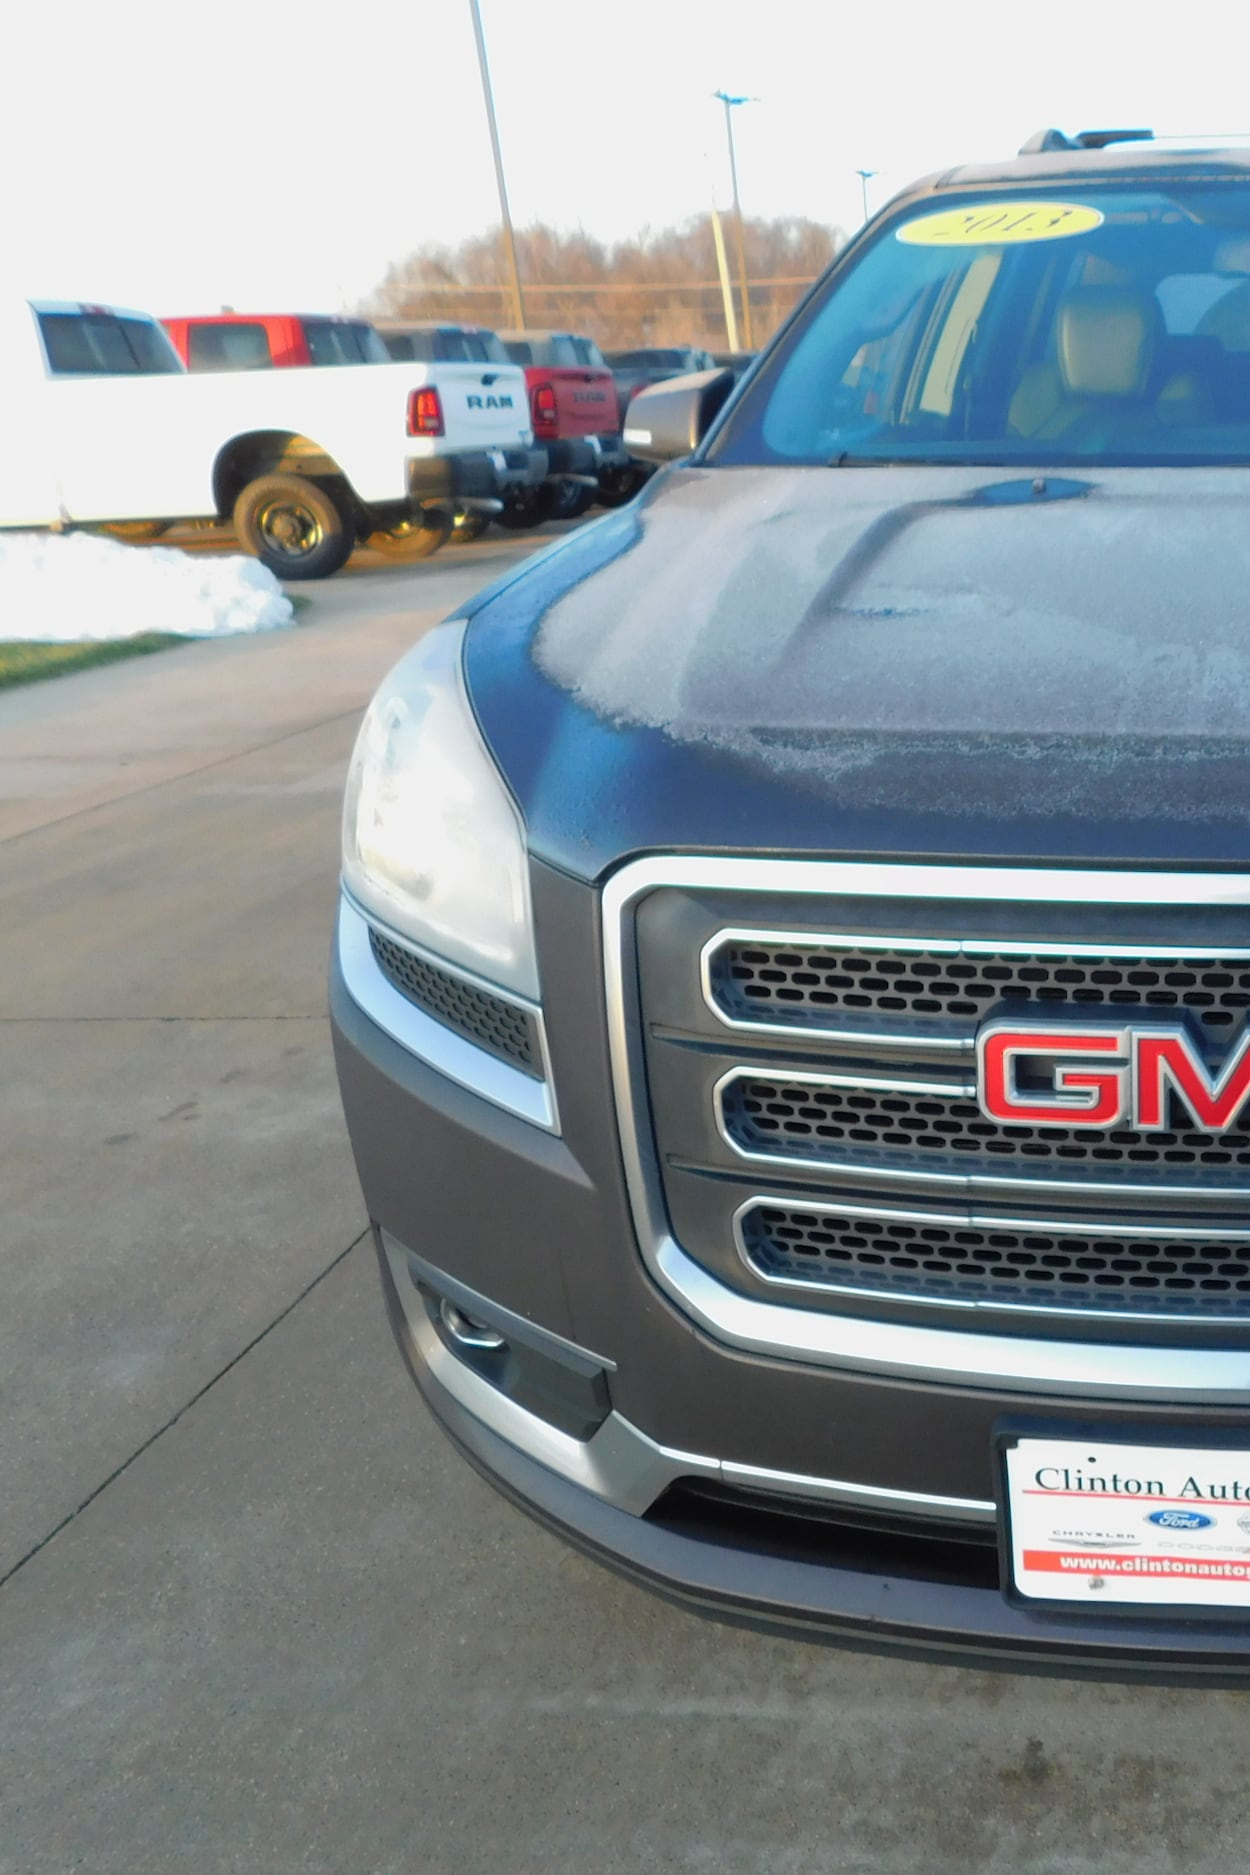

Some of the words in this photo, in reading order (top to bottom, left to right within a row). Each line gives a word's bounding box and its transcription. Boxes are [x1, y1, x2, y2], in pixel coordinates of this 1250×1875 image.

[465, 394, 513, 410] RAM
[1034, 1466, 1165, 1498] Clinton
[1157, 1511, 1201, 1529] Ford
[1052, 1529, 1137, 1540] CHRYSLER
